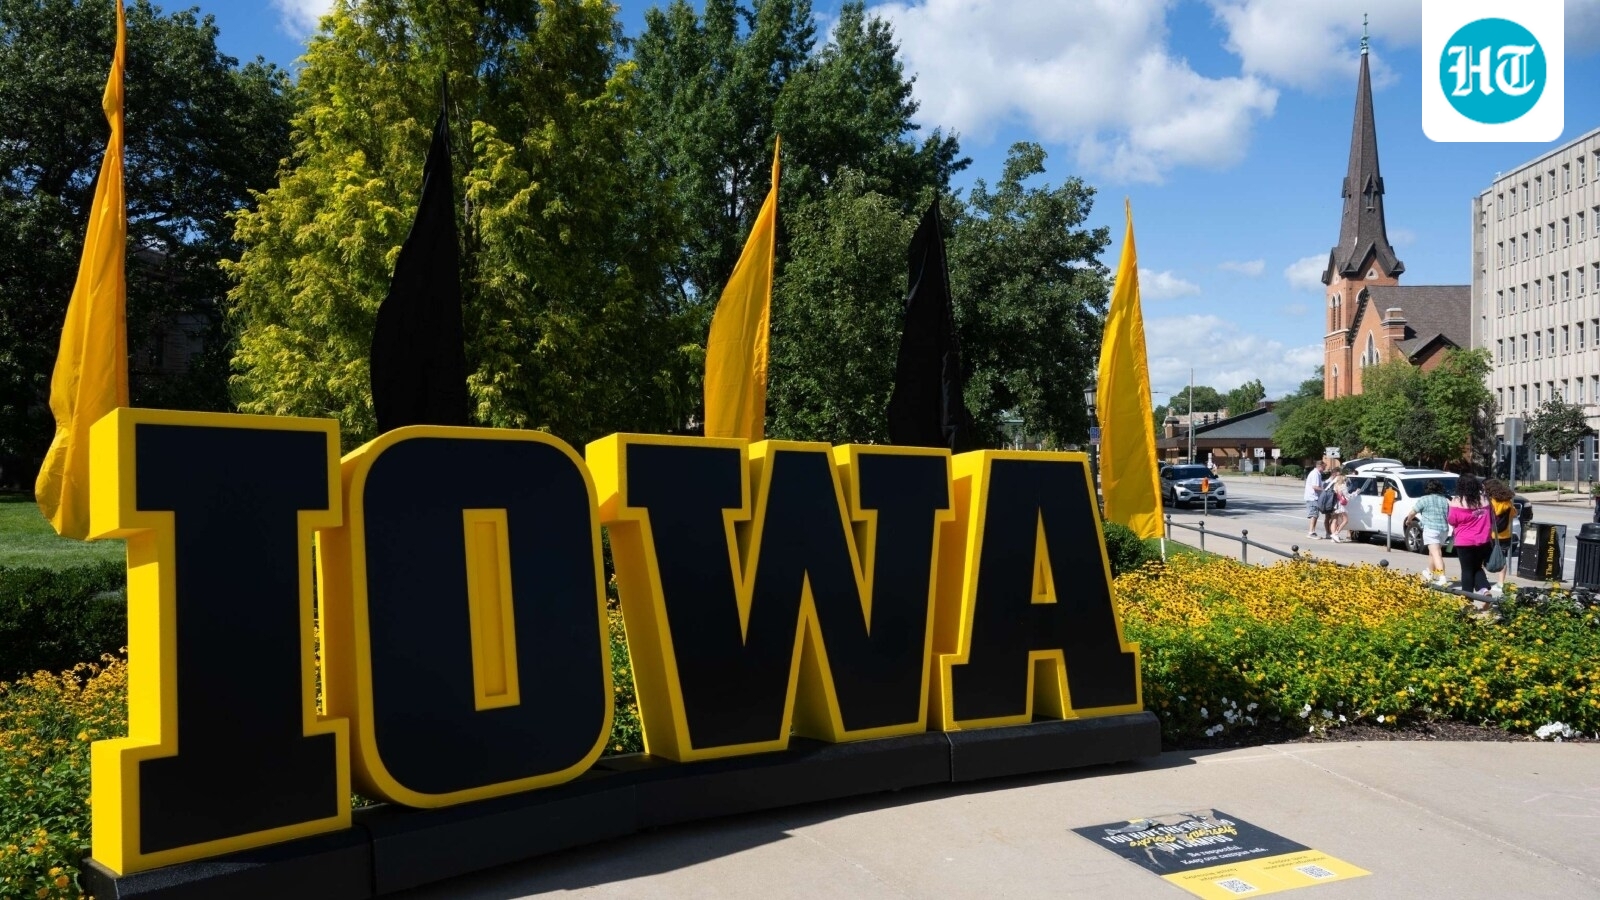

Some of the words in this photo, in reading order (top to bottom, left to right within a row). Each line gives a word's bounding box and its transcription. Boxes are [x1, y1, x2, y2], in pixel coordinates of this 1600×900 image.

[1547, 546, 1555, 562] Daily
[89, 407, 1144, 876] IOWA
[1101, 834, 1133, 844] YOU
[1127, 828, 1165, 840] HAVE
